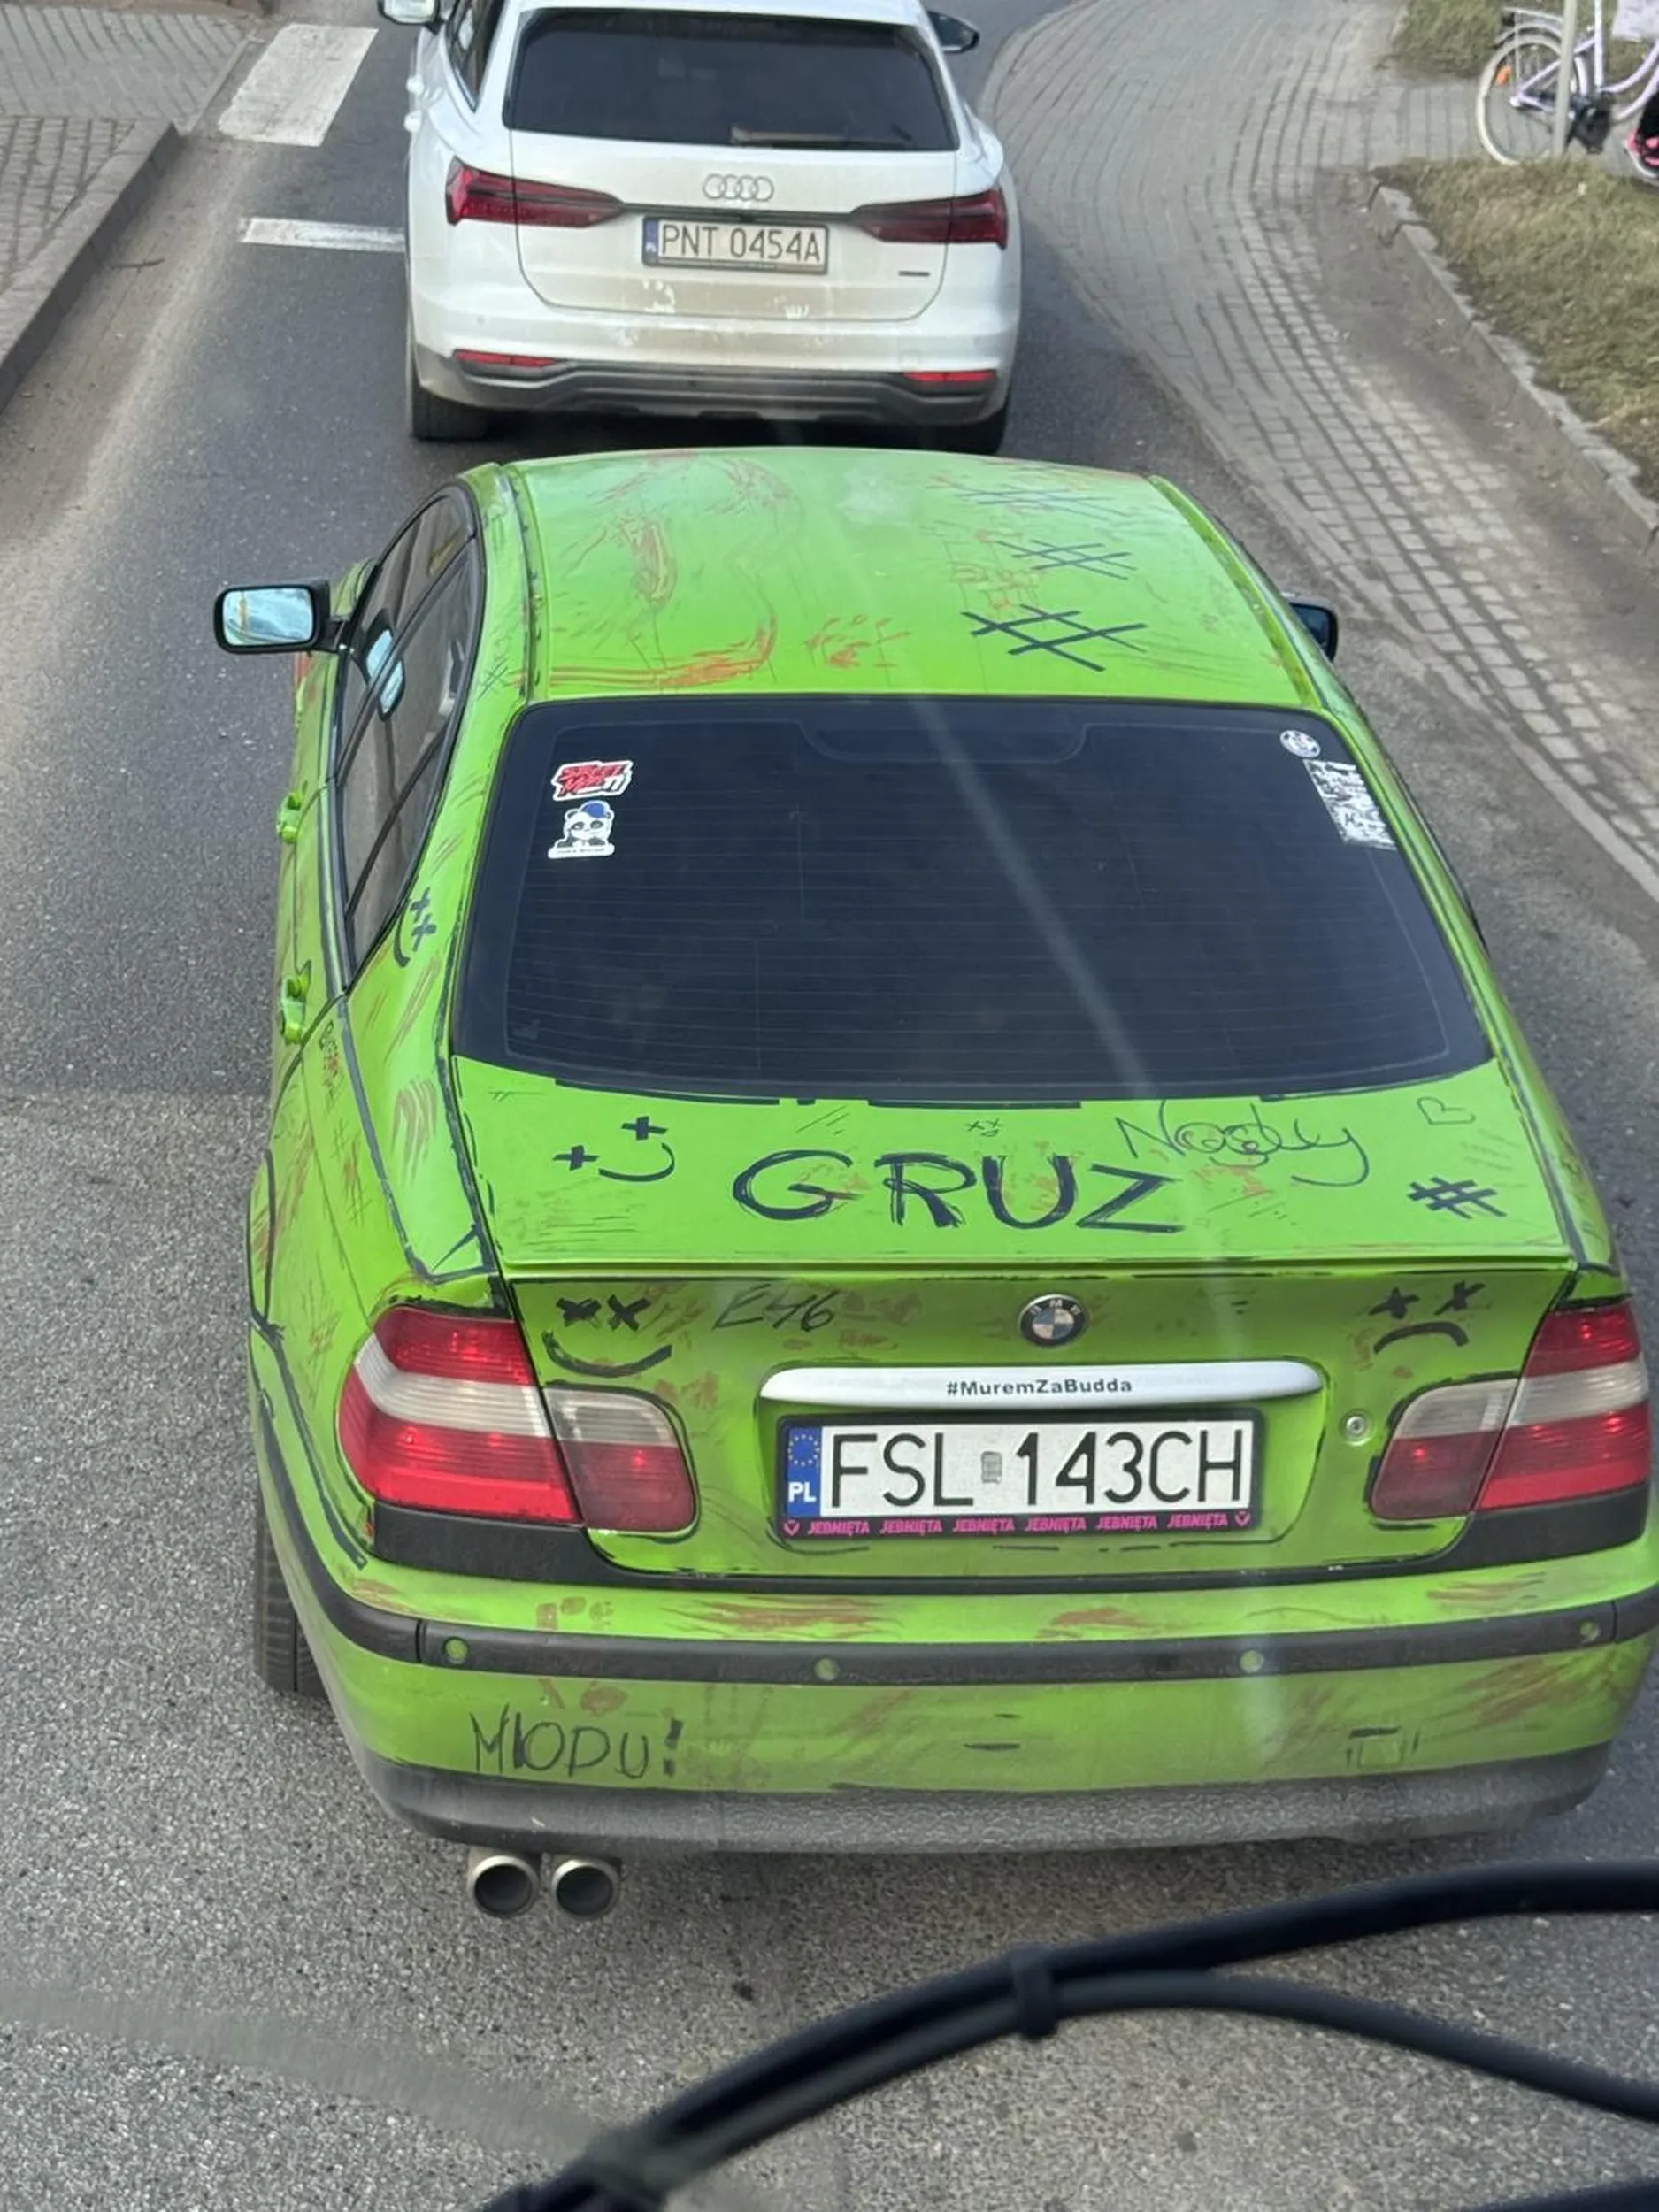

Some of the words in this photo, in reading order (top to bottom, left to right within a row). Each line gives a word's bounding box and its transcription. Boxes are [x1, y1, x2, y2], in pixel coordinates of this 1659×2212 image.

[663, 224, 718, 257] PNT
[730, 227, 820, 263] 0454A
[733, 1149, 1184, 1233] GRUZ
[712, 1284, 841, 1333] E46
[946, 1378, 1133, 1396] #MuremZaBudda
[832, 1432, 974, 1508] FSL
[1016, 1429, 1244, 1505] 143CH
[787, 1482, 816, 1502] PL
